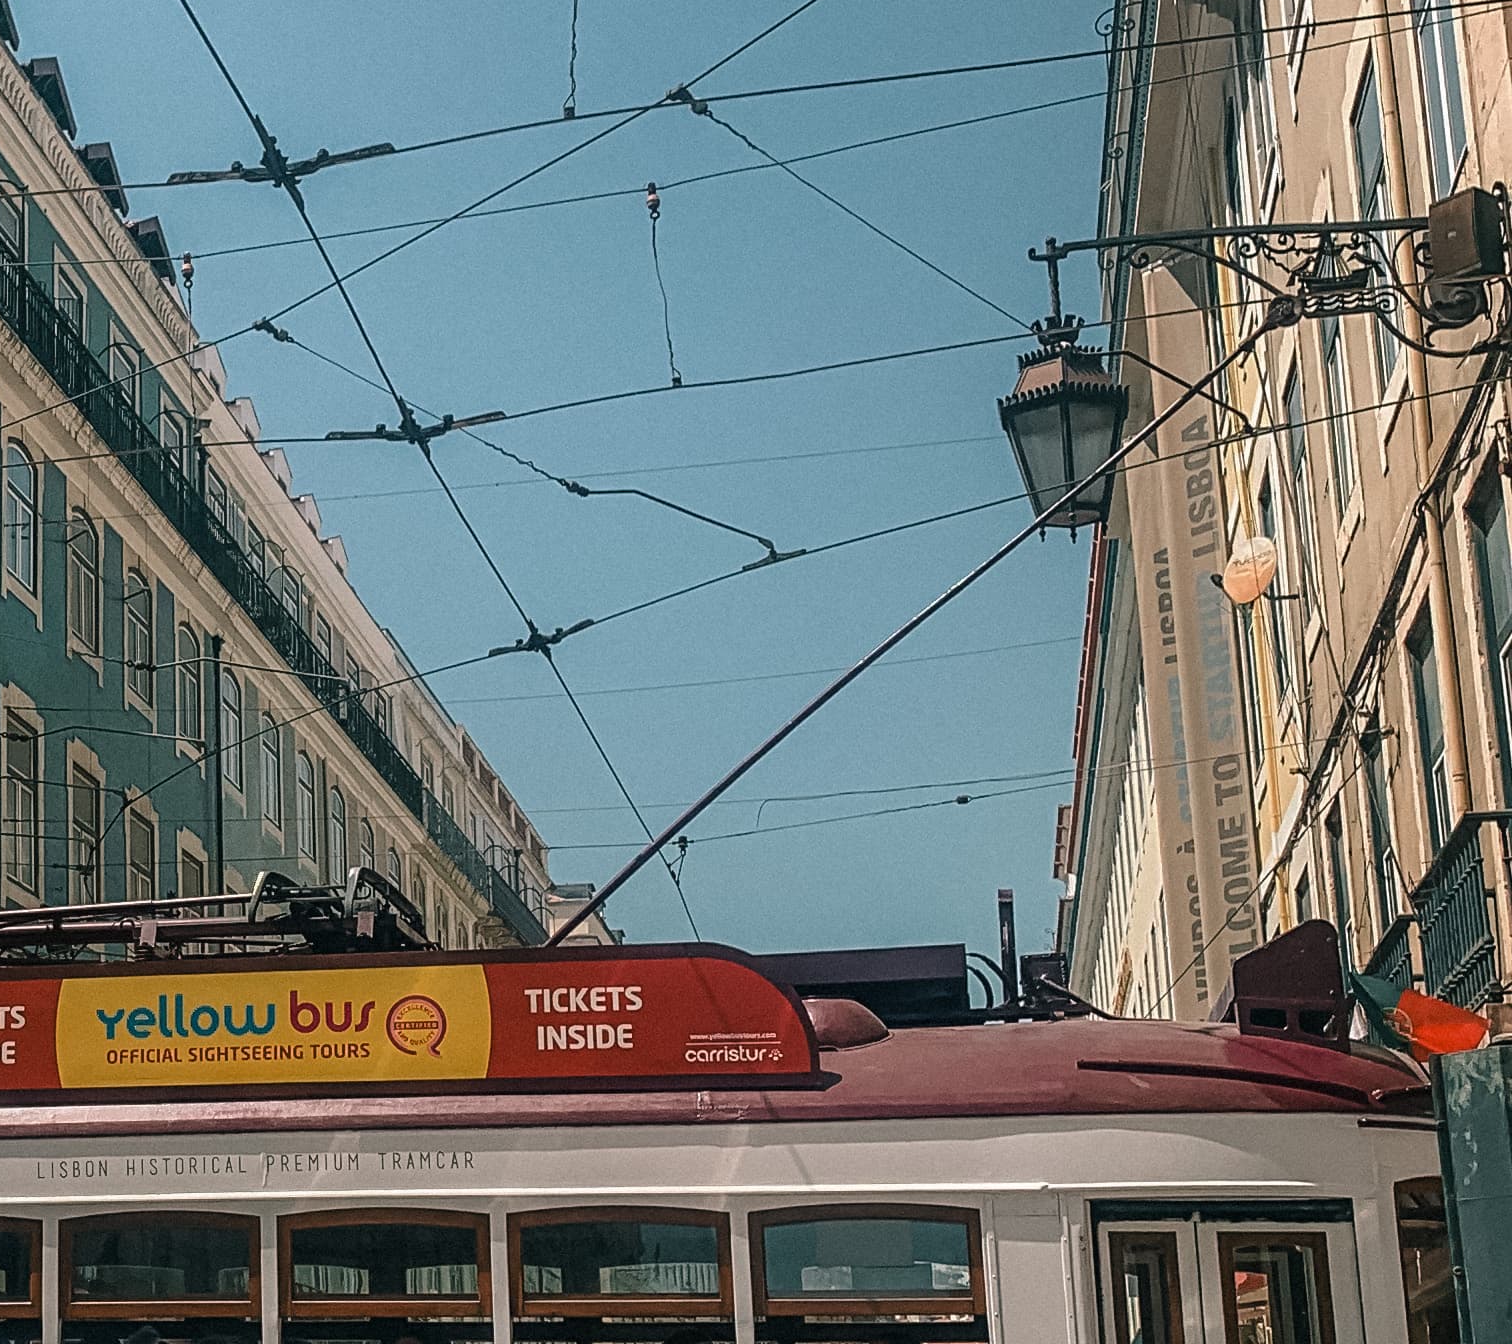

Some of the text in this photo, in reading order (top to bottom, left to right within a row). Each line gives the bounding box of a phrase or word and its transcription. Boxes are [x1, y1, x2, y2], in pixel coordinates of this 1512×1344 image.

[1181, 414, 1261, 968] LCOME TO STARTUP LISBOA
[524, 985, 643, 1014] TICKETS
[96, 989, 376, 1040] yellow bus
[537, 1022, 634, 1051] INSIDE
[106, 1041, 370, 1065] OFFICIAL SIGHTSEEING TOURS
[685, 1045, 767, 1062] carristur
[37, 1151, 475, 1179] LISBON HISTORICAL PREMIUM TRAMCAR
